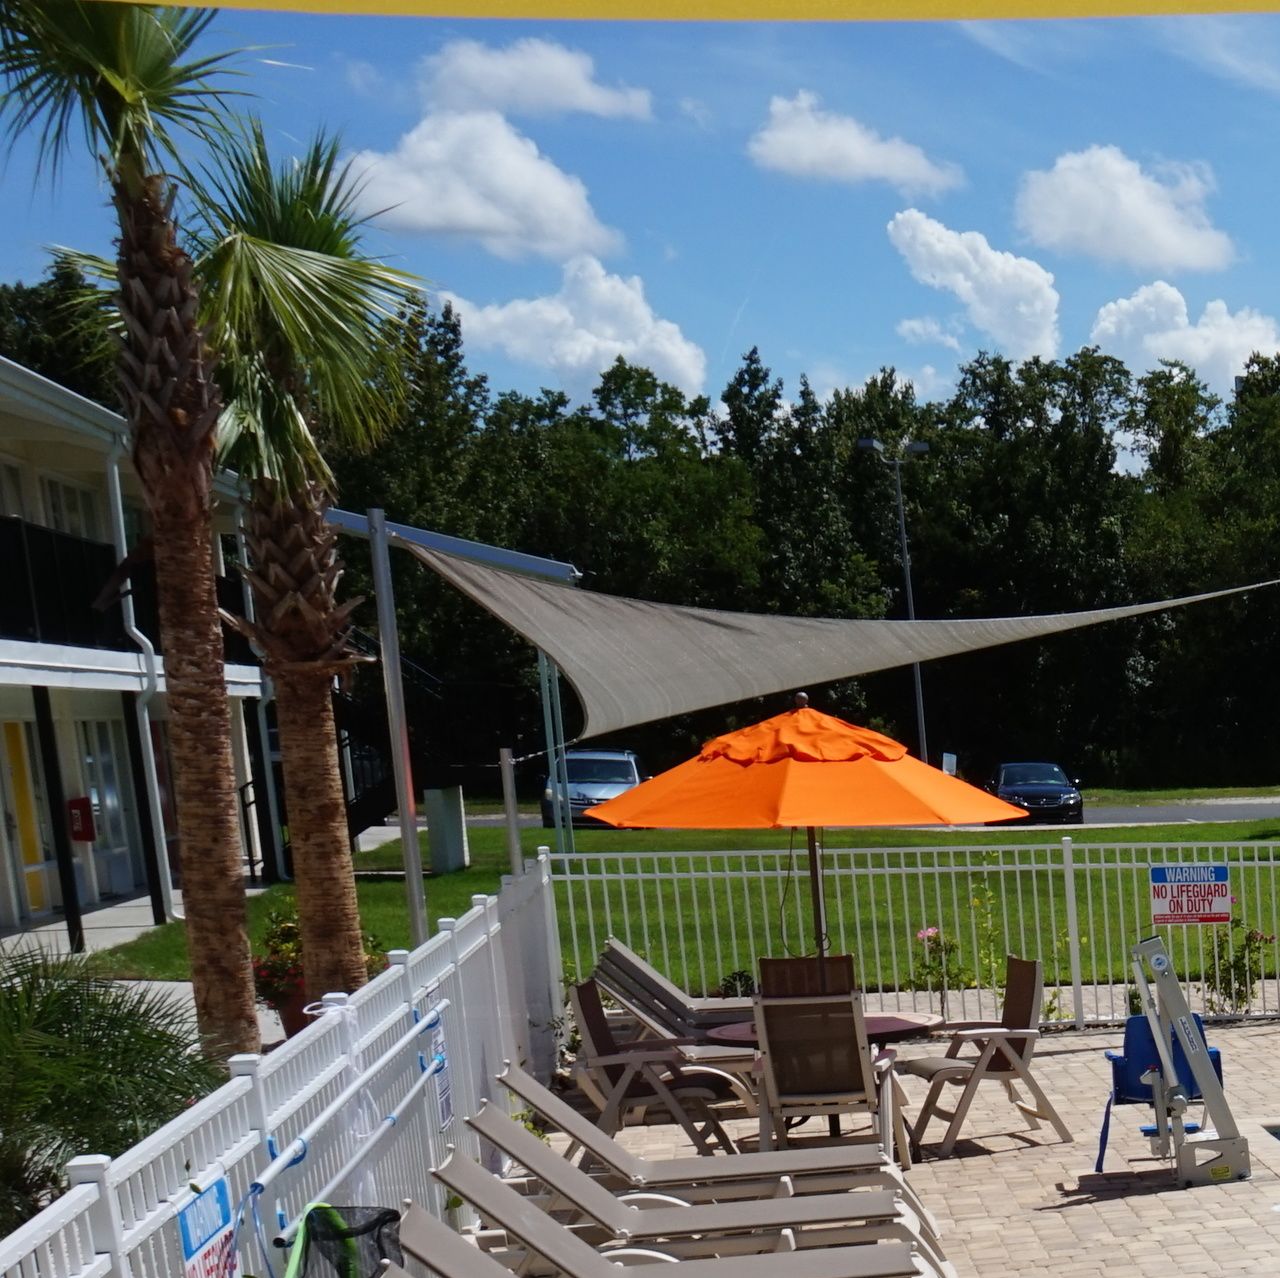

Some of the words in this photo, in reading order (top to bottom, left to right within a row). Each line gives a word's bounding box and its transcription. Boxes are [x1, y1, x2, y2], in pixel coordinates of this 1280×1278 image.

[1165, 867, 1215, 882] WARNING
[1153, 885, 1167, 899] NO
[1171, 884, 1227, 899] LIFEGUARD
[1169, 899, 1183, 913] ON
[1187, 899, 1213, 913] DUTY
